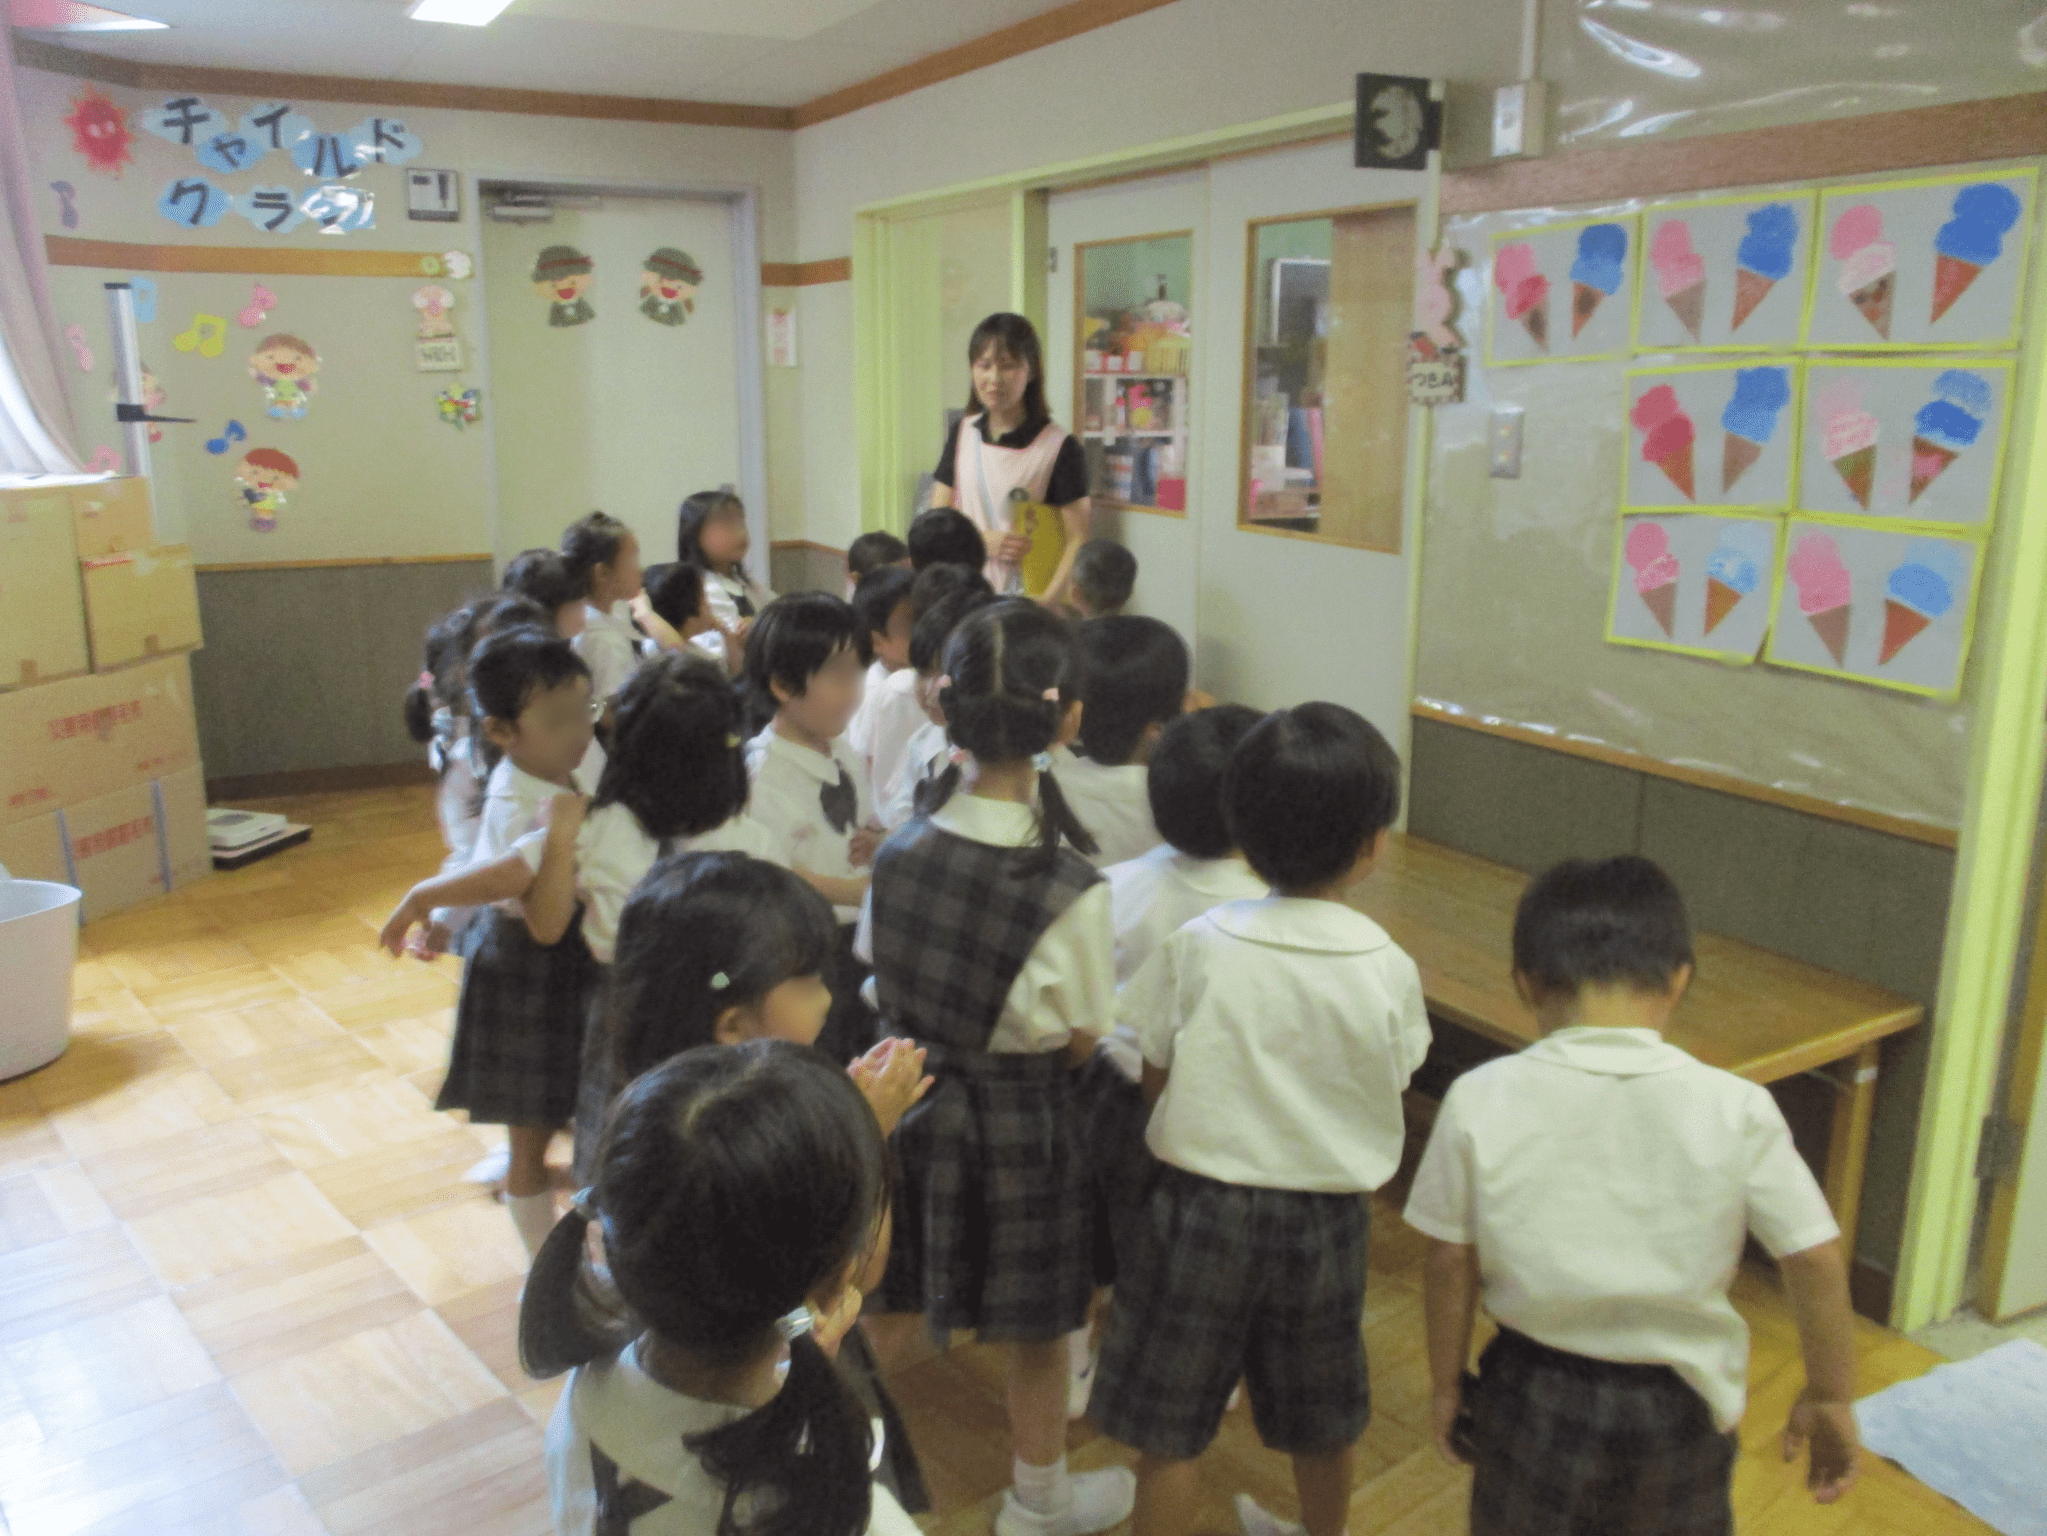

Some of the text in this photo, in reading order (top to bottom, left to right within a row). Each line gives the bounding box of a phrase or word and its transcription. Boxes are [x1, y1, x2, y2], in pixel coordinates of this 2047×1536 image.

[163, 98, 405, 177] チャイルド
